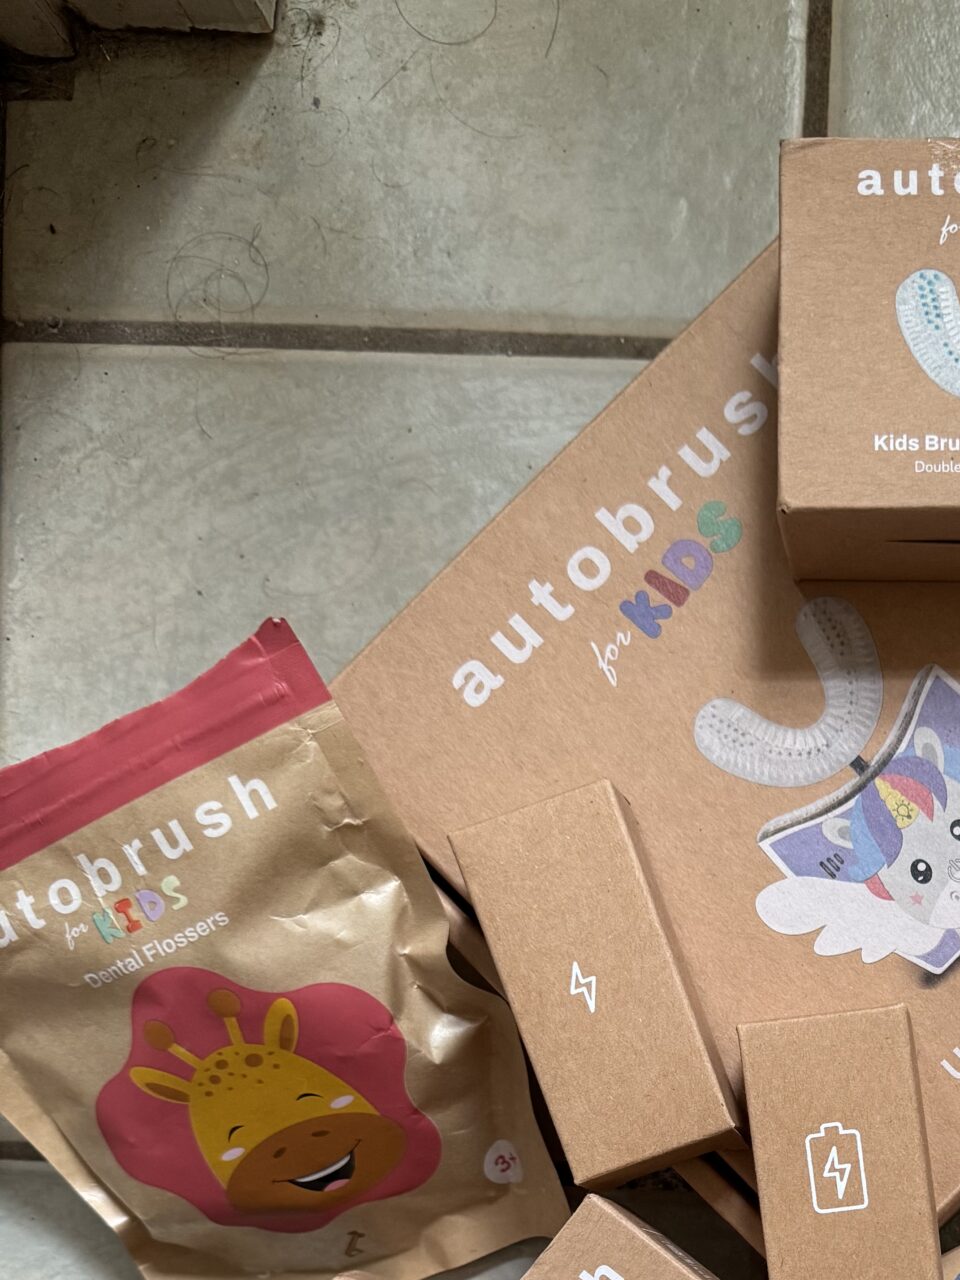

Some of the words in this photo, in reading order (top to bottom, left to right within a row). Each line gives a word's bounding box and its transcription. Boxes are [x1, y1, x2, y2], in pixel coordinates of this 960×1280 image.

[873, 434, 920, 452] Kids
[590, 630, 632, 687] for
[618, 500, 743, 640] KIDS
[63, 921, 90, 951] for
[91, 875, 189, 945] KIDS
[83, 948, 145, 990] Dental
[141, 910, 230, 963] Flossers
[493, 1152, 518, 1174] 3+
